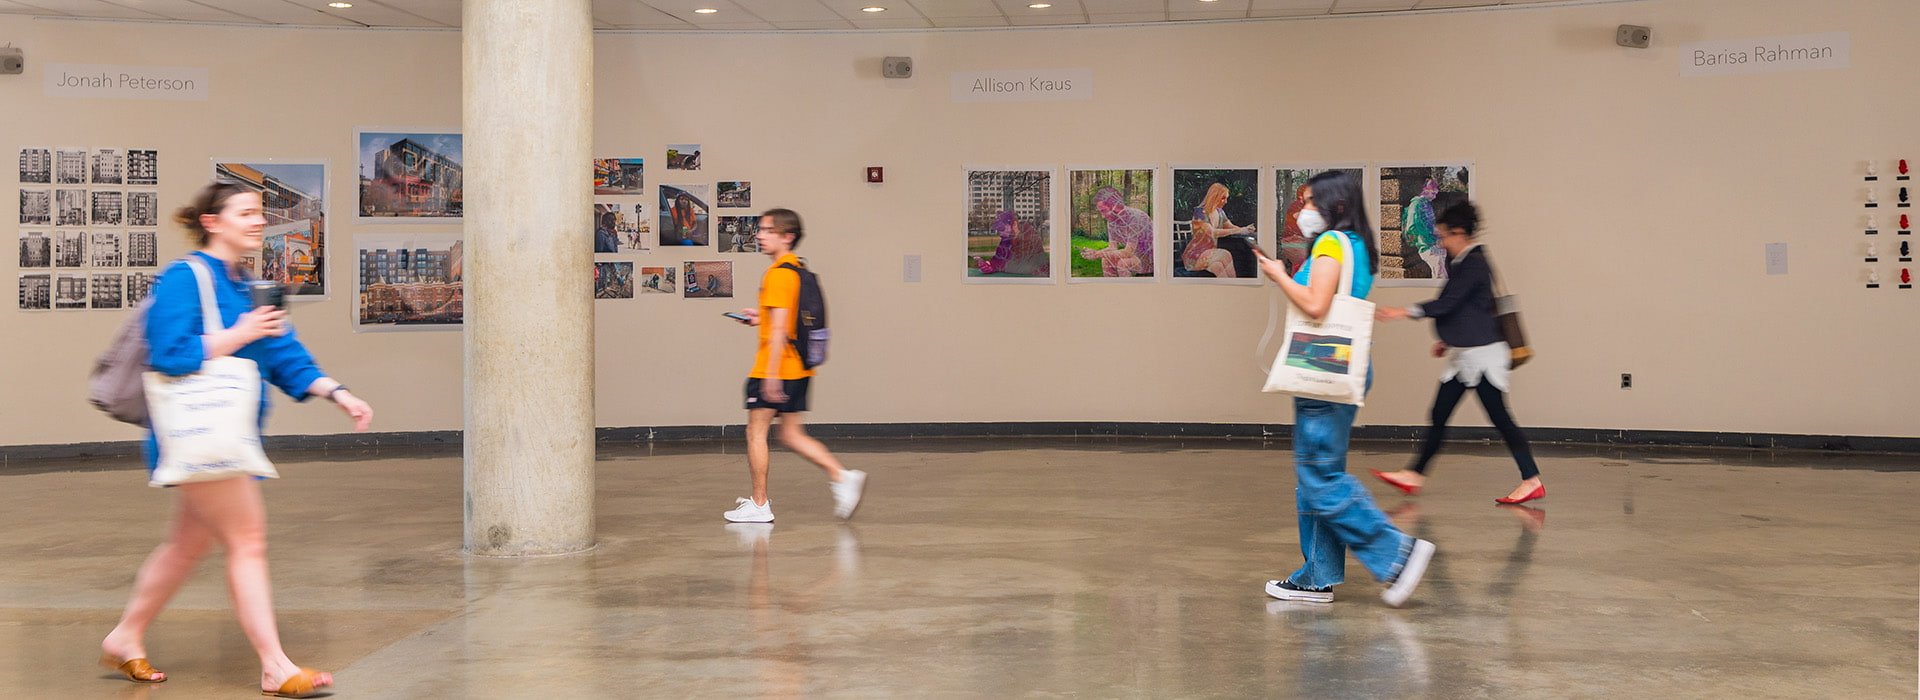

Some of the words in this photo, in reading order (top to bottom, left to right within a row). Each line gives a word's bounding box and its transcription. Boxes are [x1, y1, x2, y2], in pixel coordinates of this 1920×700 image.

[1694, 49, 1748, 66] Barisa
[1754, 44, 1832, 62] Rahman
[57, 72, 113, 88] Jonah
[119, 73, 194, 90] Peterson
[972, 78, 1024, 92] Allison
[1029, 76, 1072, 91] Kraus
